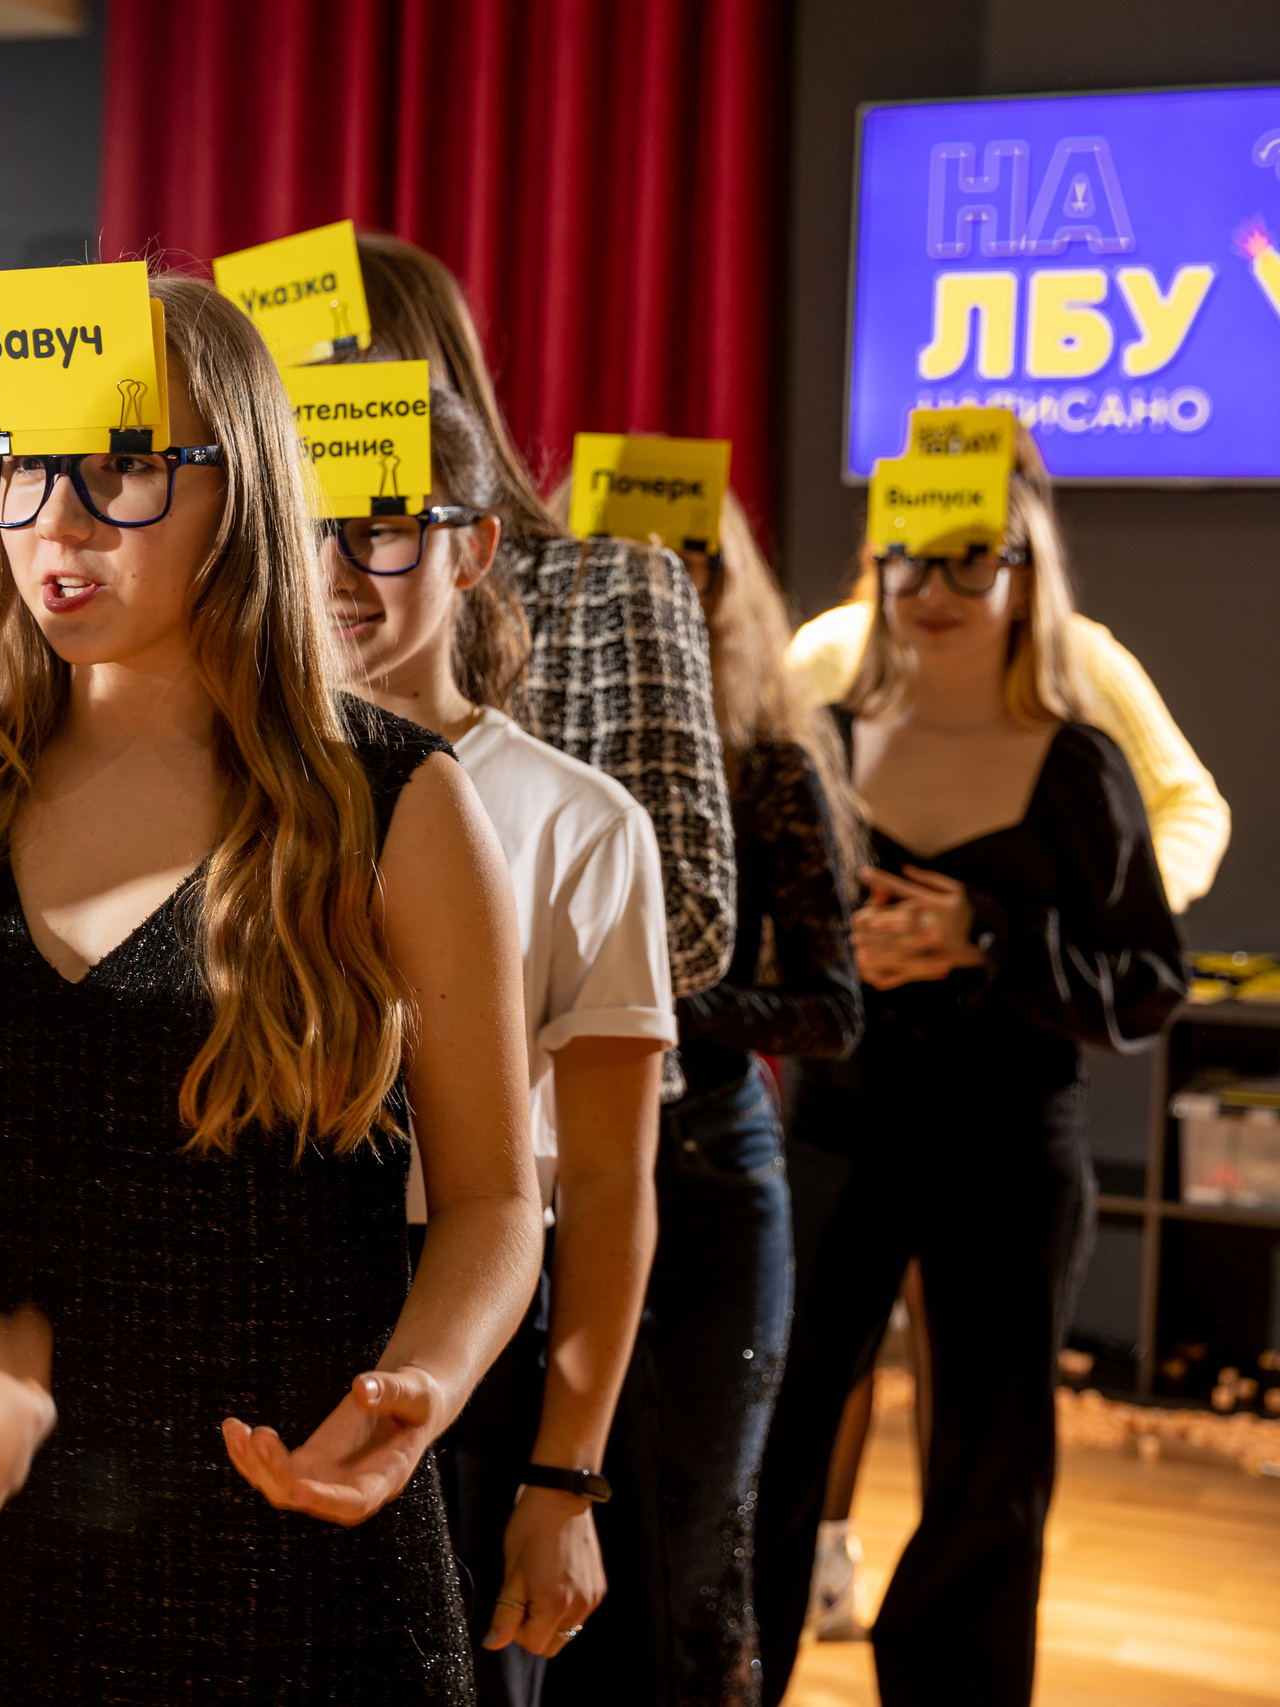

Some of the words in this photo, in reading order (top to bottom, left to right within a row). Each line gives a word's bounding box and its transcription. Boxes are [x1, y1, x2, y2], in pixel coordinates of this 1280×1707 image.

[928, 138, 1135, 258] НА
[240, 272, 337, 315] Указка
[917, 264, 1216, 380] ЛБУ
